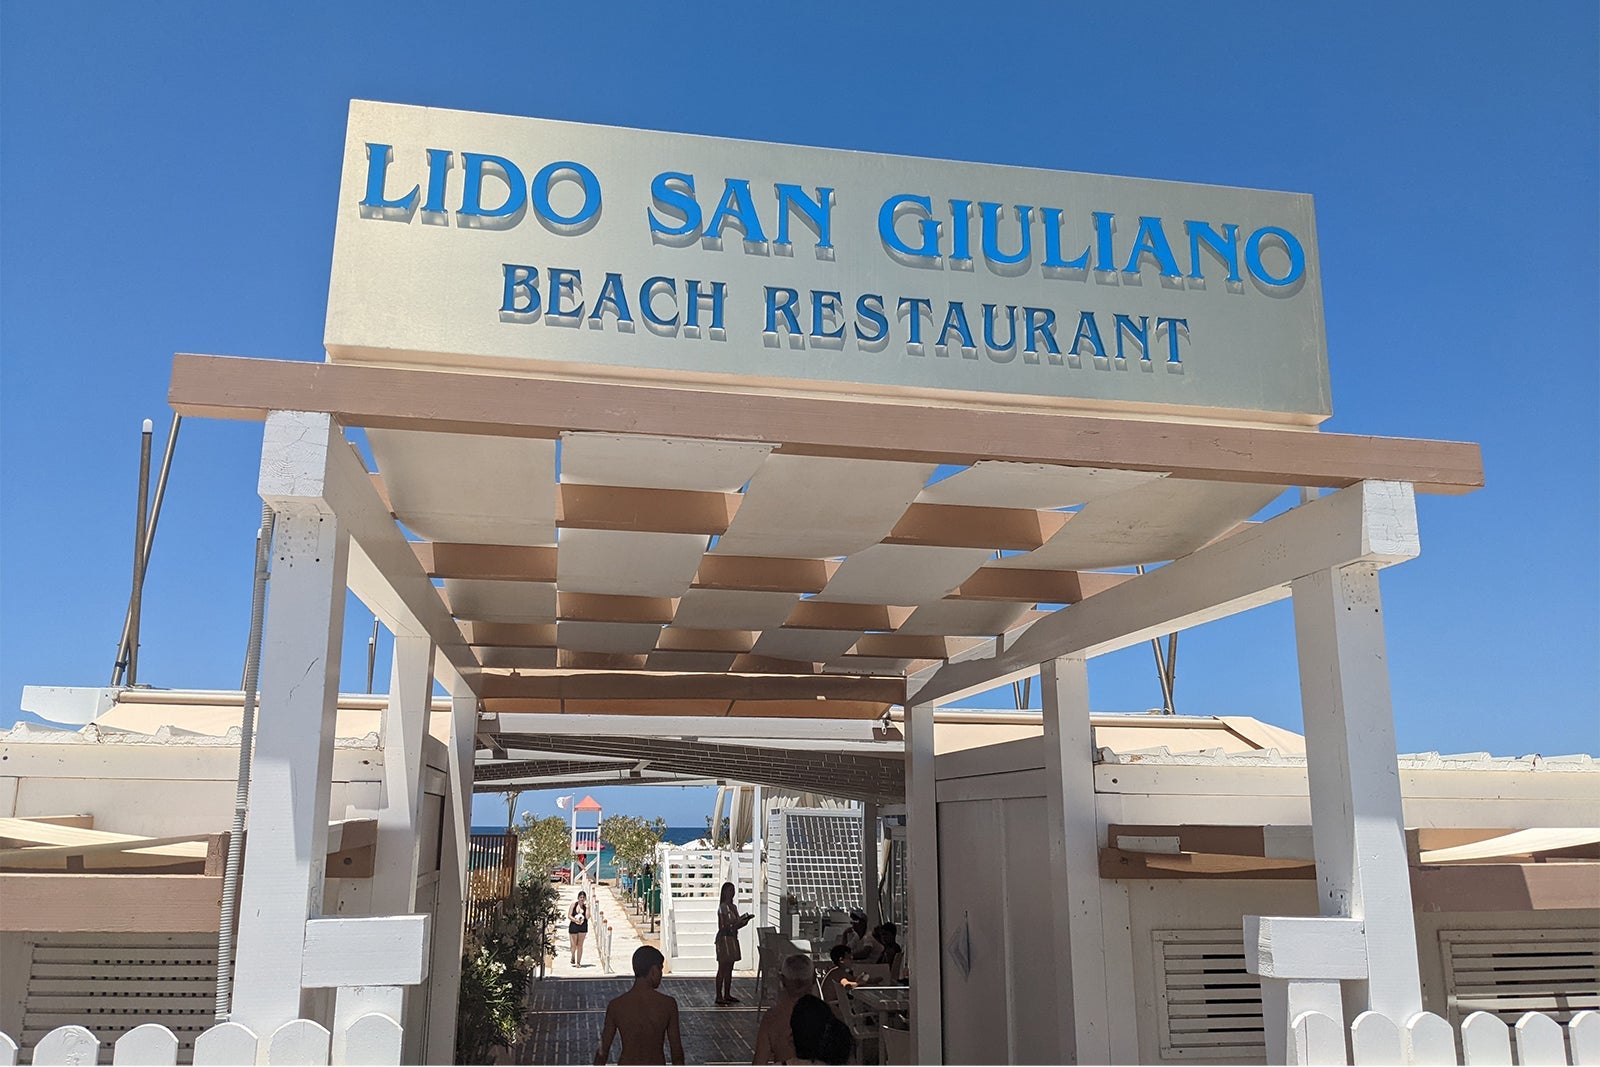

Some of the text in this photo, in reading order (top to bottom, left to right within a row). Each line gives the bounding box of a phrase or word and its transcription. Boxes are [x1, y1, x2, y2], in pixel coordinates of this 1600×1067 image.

[360, 142, 1306, 287] LIDO SAN GIULIANO
[500, 263, 1190, 364] BEACH RESTAURANT
